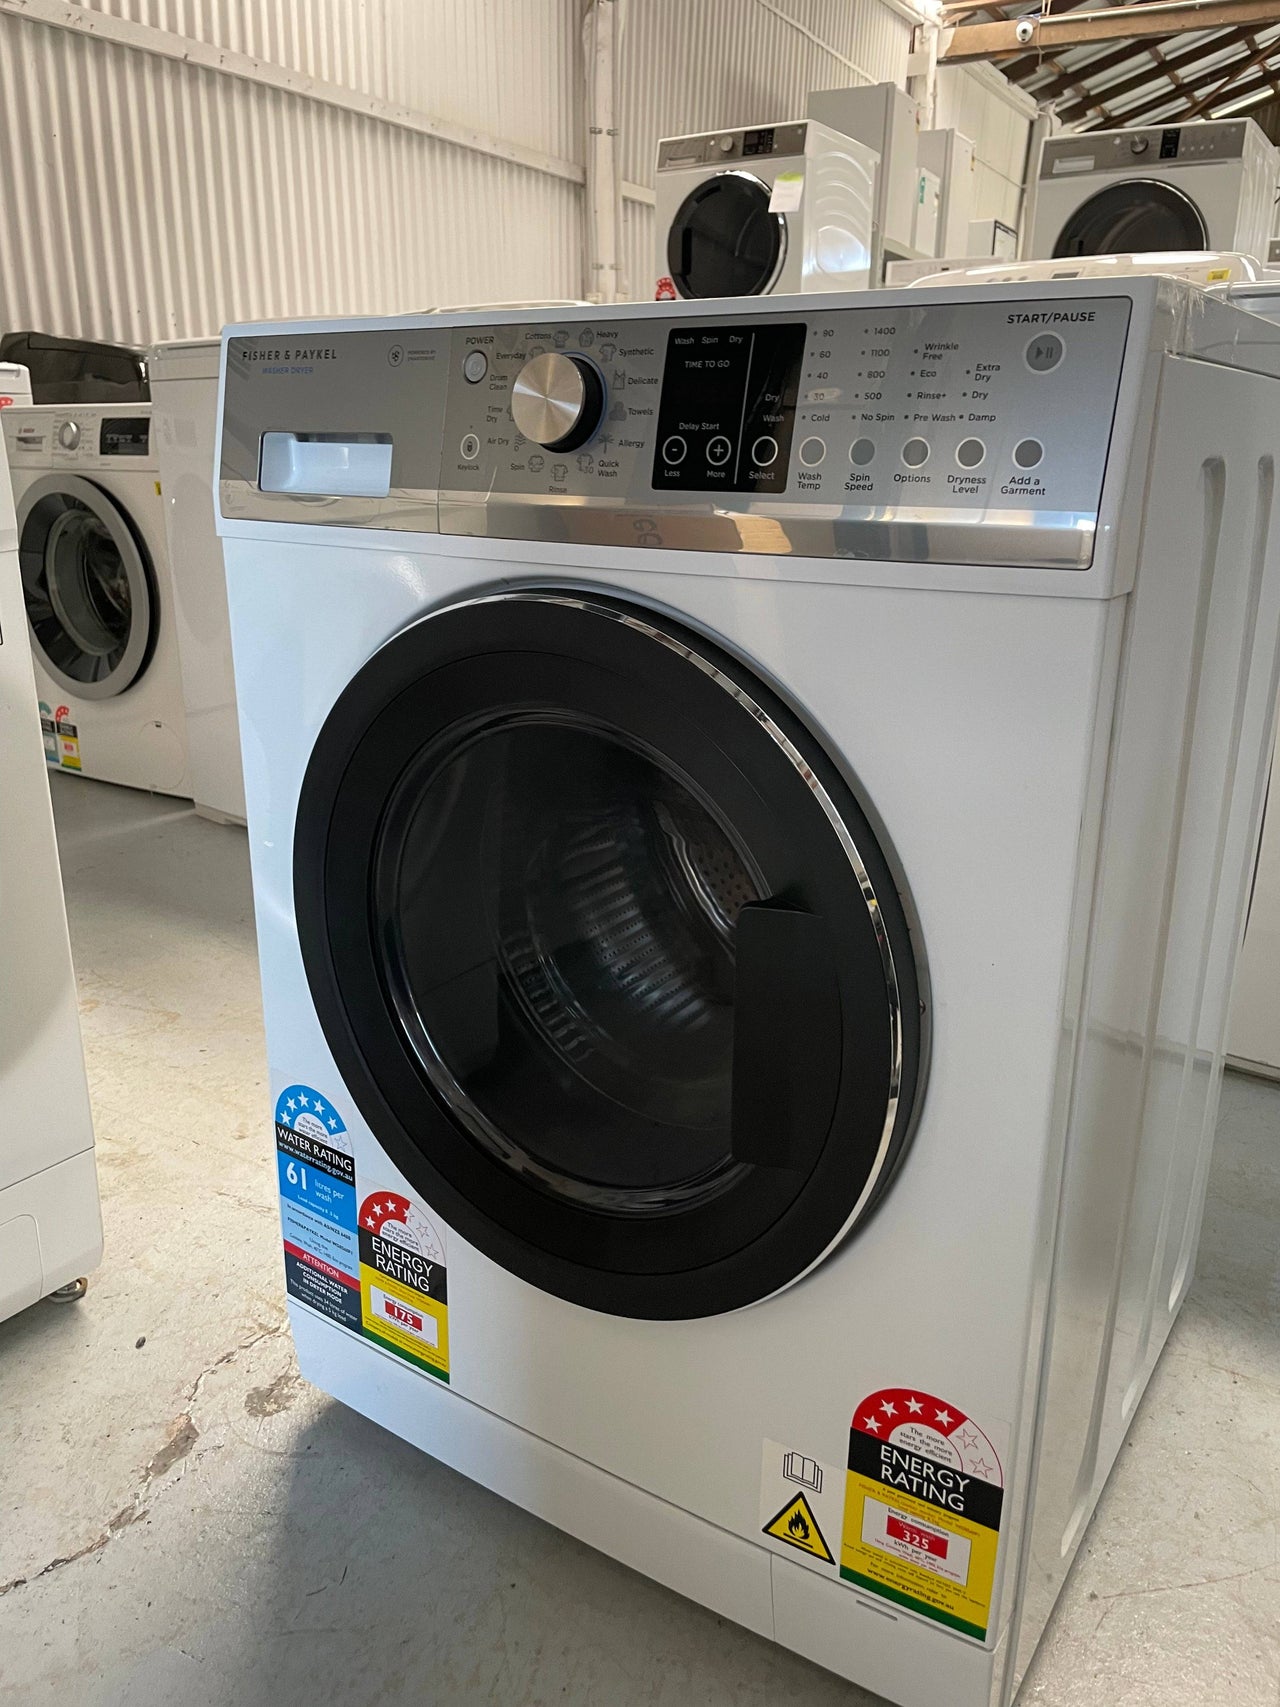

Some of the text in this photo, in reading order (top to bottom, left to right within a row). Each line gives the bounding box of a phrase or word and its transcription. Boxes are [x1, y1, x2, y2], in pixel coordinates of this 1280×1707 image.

[1007, 312, 1096, 324] START/PAUSE
[596, 331, 619, 339] Heavy
[823, 329, 834, 337] 90
[874, 327, 896, 335] 1400
[466, 336, 494, 345] POWER
[674, 336, 743, 345] Wash Spin Dry
[924, 343, 959, 351] Wrinkle
[242, 349, 337, 361] FISHER & PAYKEL
[496, 352, 526, 361] Everyday
[619, 349, 654, 357] Synthetic
[819, 351, 831, 359] 60
[871, 349, 890, 357] 1100
[717, 360, 731, 368] GO
[262, 367, 314, 375] WASHER DRYER
[920, 370, 937, 378] Eco
[817, 372, 829, 380] 40
[974, 374, 991, 383] Dry
[627, 377, 659, 385] Delicate
[489, 383, 507, 391] Clean
[765, 394, 780, 402] Dry
[813, 392, 825, 400] 30
[864, 392, 883, 400] 500
[917, 392, 947, 400] Rinse+
[971, 391, 989, 400] Dry
[488, 406, 503, 414] Time
[628, 407, 654, 416] Towels
[486, 415, 498, 424] Dry
[763, 414, 785, 423] Wash
[811, 414, 831, 423] Cold
[860, 413, 895, 423] No Spin
[914, 414, 956, 422] Pre Wash
[968, 414, 997, 423] Damp
[679, 422, 720, 431] Delay Start
[498, 438, 509, 446] Dry
[618, 440, 646, 449] Allergy
[457, 464, 480, 472] Keylock
[511, 463, 526, 472] Spin
[599, 460, 620, 469] Quick
[598, 470, 618, 478] Wash
[749, 471, 775, 480] Select
[797, 472, 822, 481] Wash
[850, 473, 871, 482] Spin
[893, 474, 932, 483] Options
[947, 475, 987, 485] Dryness
[1009, 476, 1029, 486] Add
[549, 486, 568, 494] Rinse
[797, 481, 821, 491] Temp
[844, 482, 874, 492] Speed
[952, 485, 979, 494] Level
[1000, 486, 1046, 496] Garment
[277, 1127, 352, 1172] WATER RATING
[278, 1140, 353, 1183] www.waterrating.gov.au
[285, 1159, 307, 1190] 61
[314, 1178, 344, 1202] litres per
[315, 1189, 332, 1203] wash
[388, 1222, 411, 1237] The more
[372, 1236, 433, 1279] ENERGY
[302, 1251, 339, 1278] ATTENTION
[296, 1260, 347, 1294] ADDITIONAL WATER
[376, 1253, 429, 1293] RATING
[302, 1271, 341, 1297] CONSUMPTION
[302, 1277, 342, 1304] IN DRYER MODE
[394, 1306, 413, 1325] 175
[910, 1427, 944, 1445] The more
[900, 1431, 952, 1455] stars the more
[899, 1438, 951, 1463] energy efficient
[880, 1444, 970, 1494] ENERGY
[881, 1464, 964, 1512] RATING
[888, 1507, 907, 1520] Energy
[910, 1517, 949, 1538] consumption
[902, 1529, 929, 1550] 325
[894, 1540, 908, 1550] kWh
[911, 1548, 921, 1556] per
[924, 1553, 937, 1563] year
